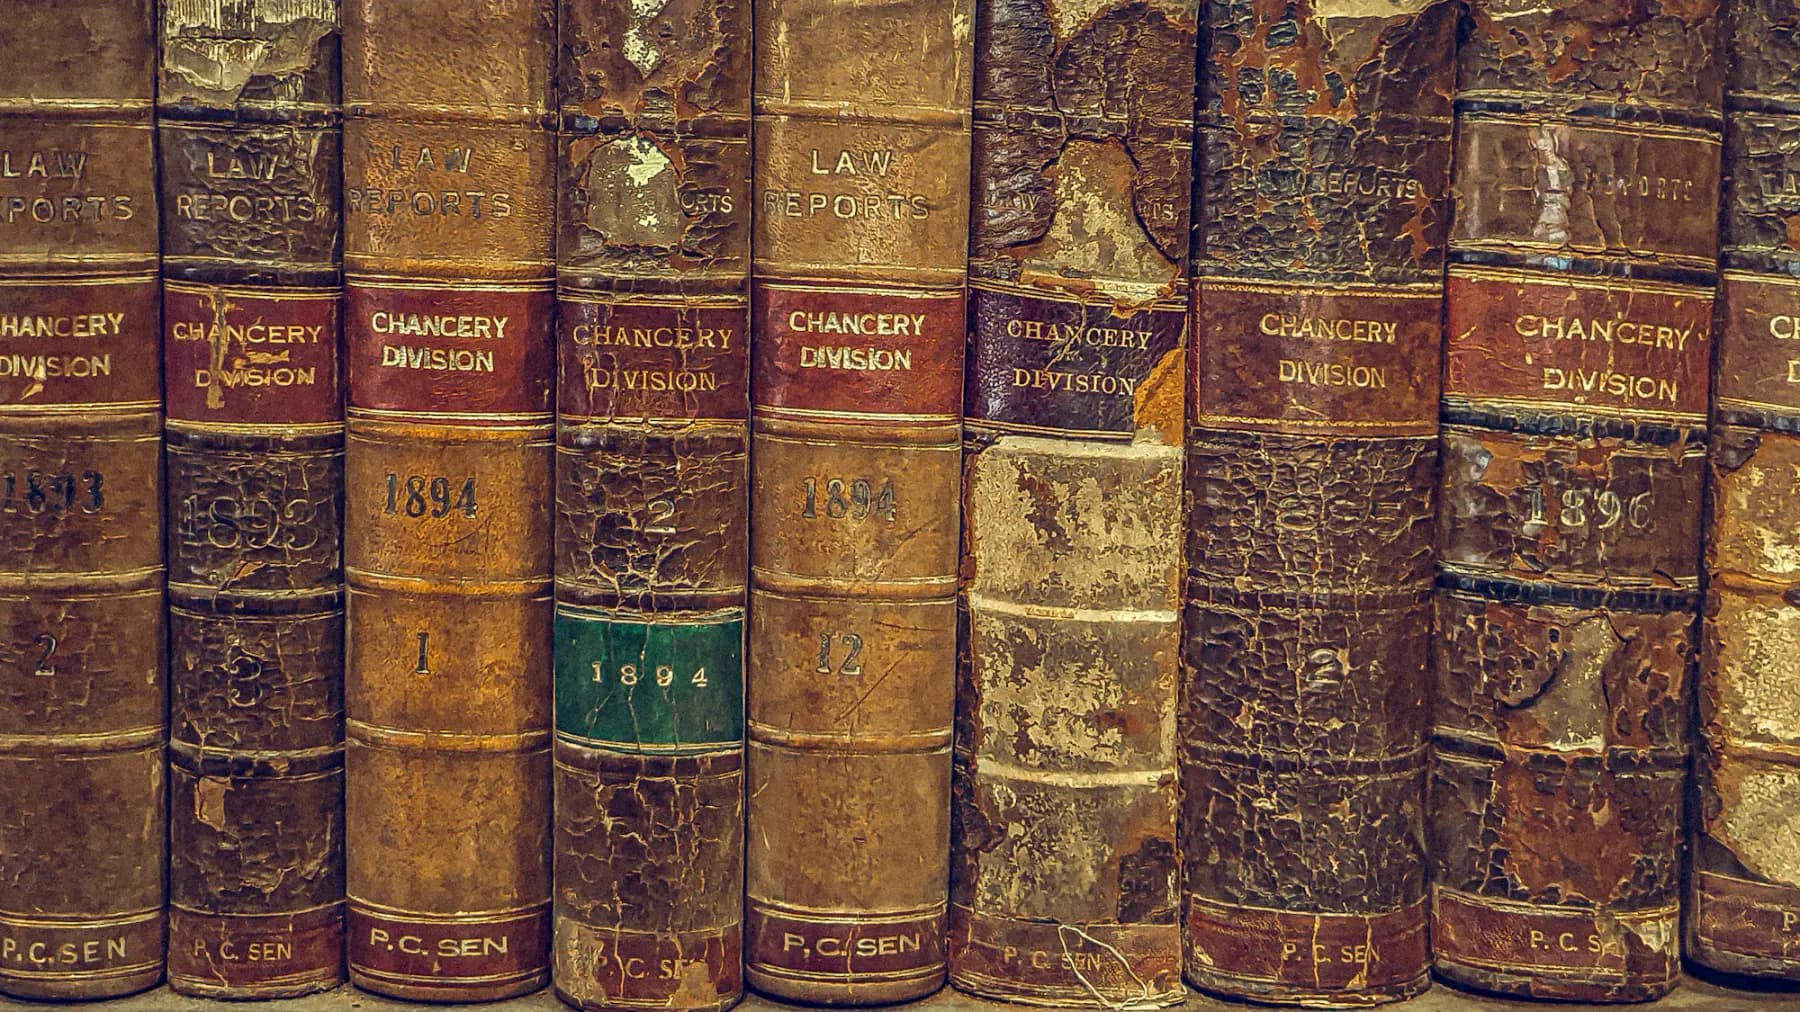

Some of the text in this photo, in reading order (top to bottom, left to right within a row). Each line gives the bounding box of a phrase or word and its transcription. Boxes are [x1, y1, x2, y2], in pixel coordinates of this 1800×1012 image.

[3, 152, 87, 177] LAW
[208, 151, 277, 180] LAW
[811, 149, 892, 177] LAW
[0, 196, 133, 223] PORTS
[176, 195, 315, 222] REPORTS
[348, 188, 513, 219] REPORTS
[680, 192, 733, 213] ORTS
[763, 189, 930, 220] REPORTS
[0, 312, 125, 337] HANCERY
[173, 321, 323, 345] CHANCERY
[371, 312, 509, 339] CHANCERY
[788, 310, 925, 337] CHANCERY
[1007, 319, 1153, 350] CHANCERY
[1259, 313, 1397, 344] CHANCERY
[1514, 314, 1693, 351] CHANCERY
[573, 325, 733, 350] CHANCERY
[382, 345, 494, 372] DIVISION
[799, 346, 913, 371] DIVISION
[195, 366, 316, 389] DVISION
[589, 367, 717, 392] DIVISION
[1013, 367, 1137, 396] DIVISION
[1278, 359, 1387, 388] DIVISION
[1543, 367, 1678, 402] DIVISION
[383, 472, 479, 519] 1894
[801, 475, 897, 523] 1894
[1522, 486, 1652, 529] 1896
[34, 634, 57, 676] 2
[816, 631, 864, 676] 12
[591, 660, 710, 688] 1894
[247, 943, 293, 961] SEN
[437, 935, 509, 958] SEN
[856, 932, 920, 957] SEN
[1341, 944, 1381, 963] SEN
[1061, 951, 1101, 972] SEN
